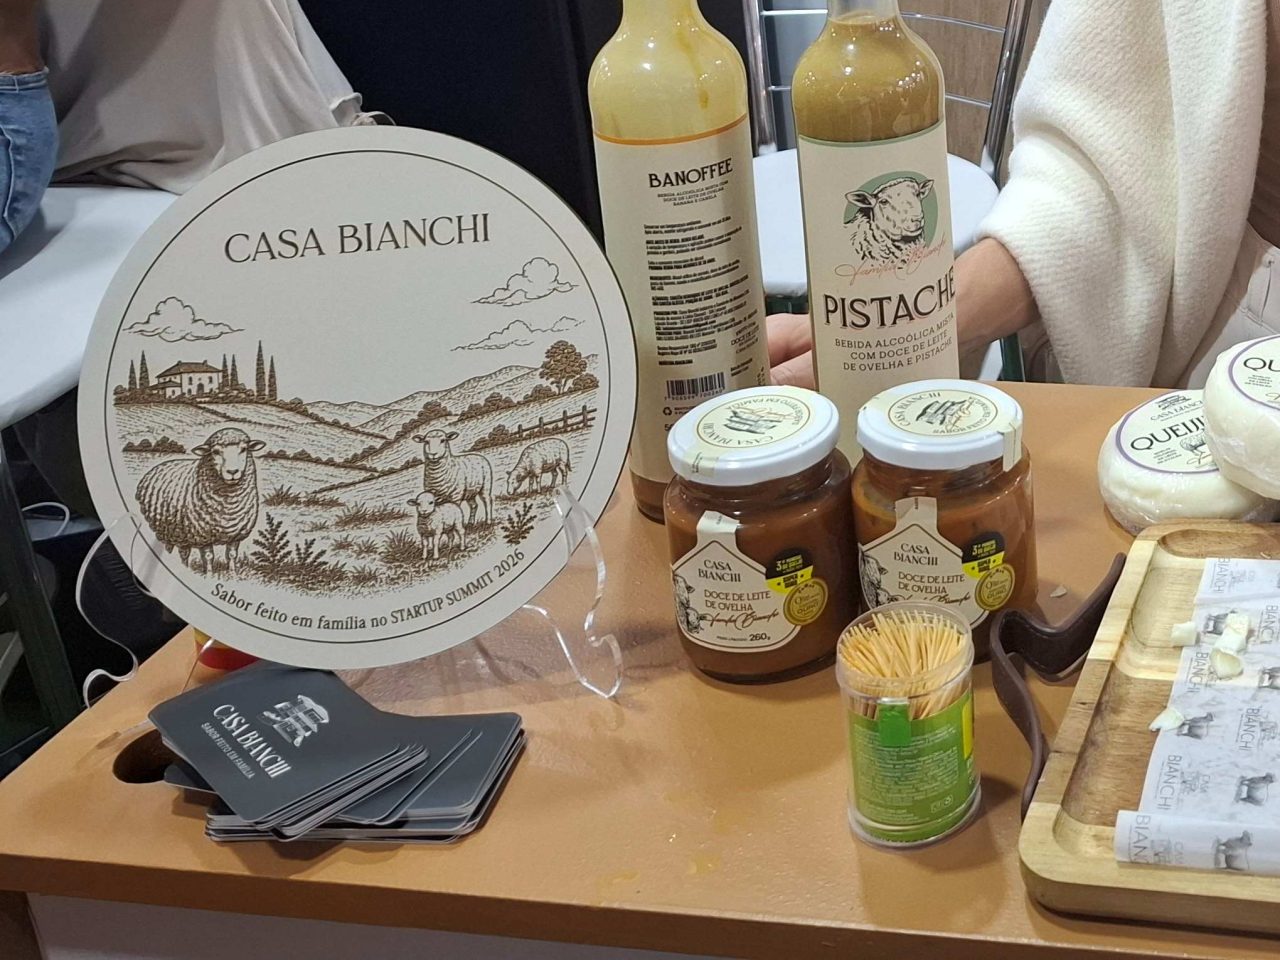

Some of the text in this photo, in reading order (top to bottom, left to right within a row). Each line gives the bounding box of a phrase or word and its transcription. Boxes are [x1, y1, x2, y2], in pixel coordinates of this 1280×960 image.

[648, 158, 733, 188] BANOFFEE
[224, 213, 490, 263] CASA BIANCHI
[823, 265, 955, 330] PISTACHE
[835, 312, 954, 349] BEBIDA ALCOÓLICA MISTA
[850, 329, 948, 360] COM DOCE DE LEITE
[844, 337, 952, 371] DE OVELHA E PISTACHE
[1130, 416, 1205, 450] QUEIJI
[704, 560, 732, 571] CASA
[894, 552, 938, 566] BIANCHI
[901, 543, 930, 555] CASA
[211, 549, 525, 631] Sabor feito em família no STARTUP SUMMIT 2026
[698, 568, 741, 582] BIANCHI
[899, 571, 965, 584] DOCE DE LEITE
[899, 582, 947, 594] DE OVELHA
[704, 590, 771, 600] DOCE DE LEITE
[705, 600, 753, 612] DE OVELHA
[1186, 651, 1209, 694] BIANCHI
[213, 704, 291, 778] CASA BIANCHI
[1238, 708, 1260, 751] BIANCHI
[1158, 755, 1182, 811] BIANCHI
[1132, 815, 1151, 863] BIAN
